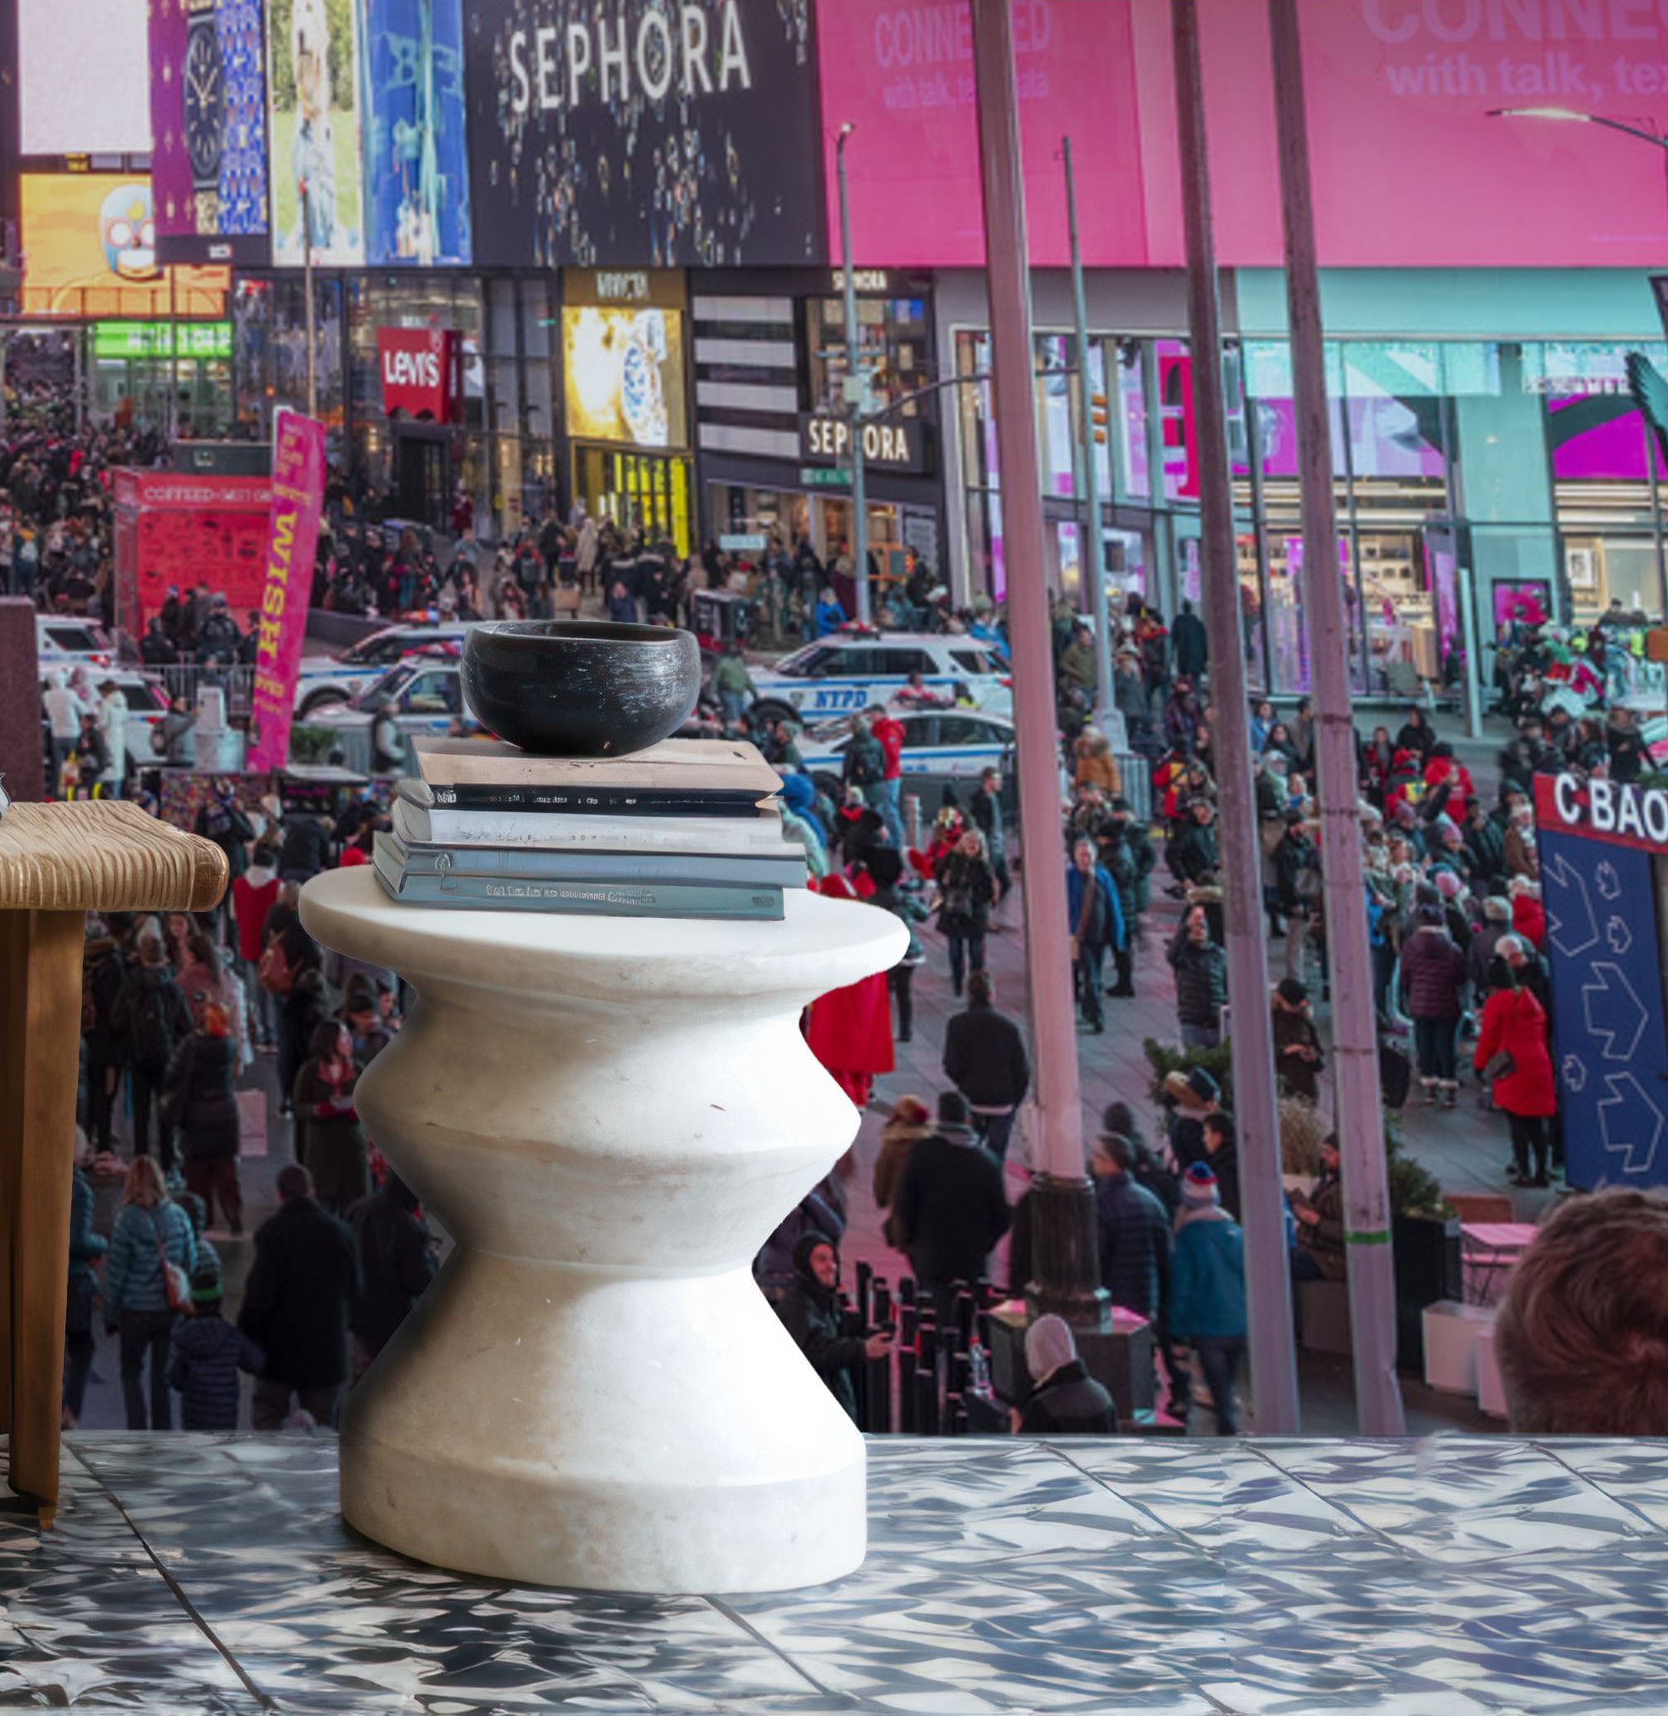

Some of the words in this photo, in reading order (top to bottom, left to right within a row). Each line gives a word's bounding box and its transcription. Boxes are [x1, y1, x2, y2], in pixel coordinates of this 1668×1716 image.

[511, 0, 752, 113] SEPHORA
[1386, 53, 1486, 96] with
[1498, 51, 1603, 102] talk,
[257, 510, 297, 660] WISH
[816, 690, 868, 709] NYPD
